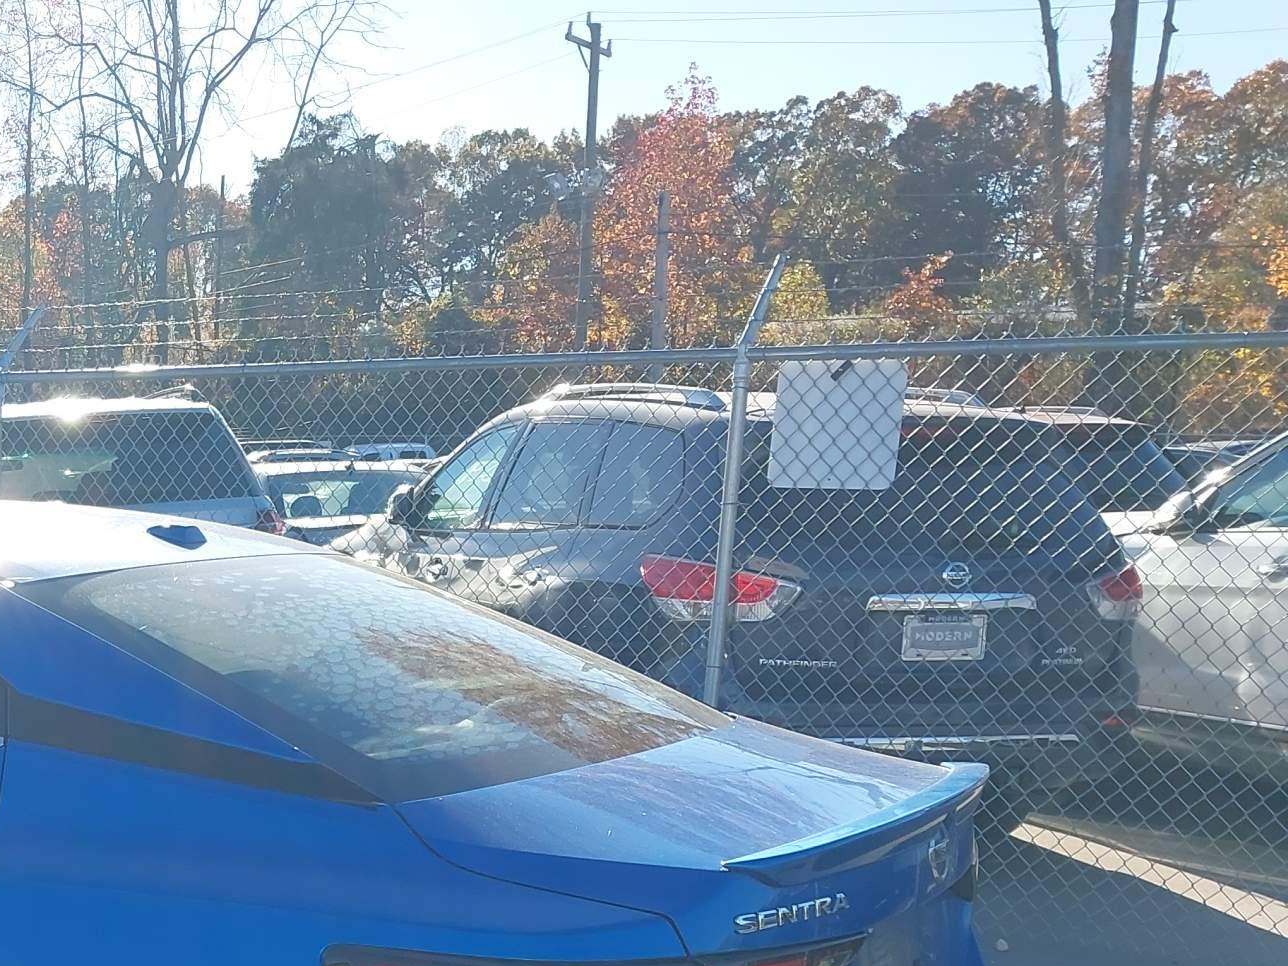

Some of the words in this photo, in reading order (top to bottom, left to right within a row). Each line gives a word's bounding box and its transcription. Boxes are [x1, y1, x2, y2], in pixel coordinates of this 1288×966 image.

[915, 631, 973, 641] MODERN
[759, 658, 838, 668] PATHFINDER
[734, 893, 851, 934] SENTRA
